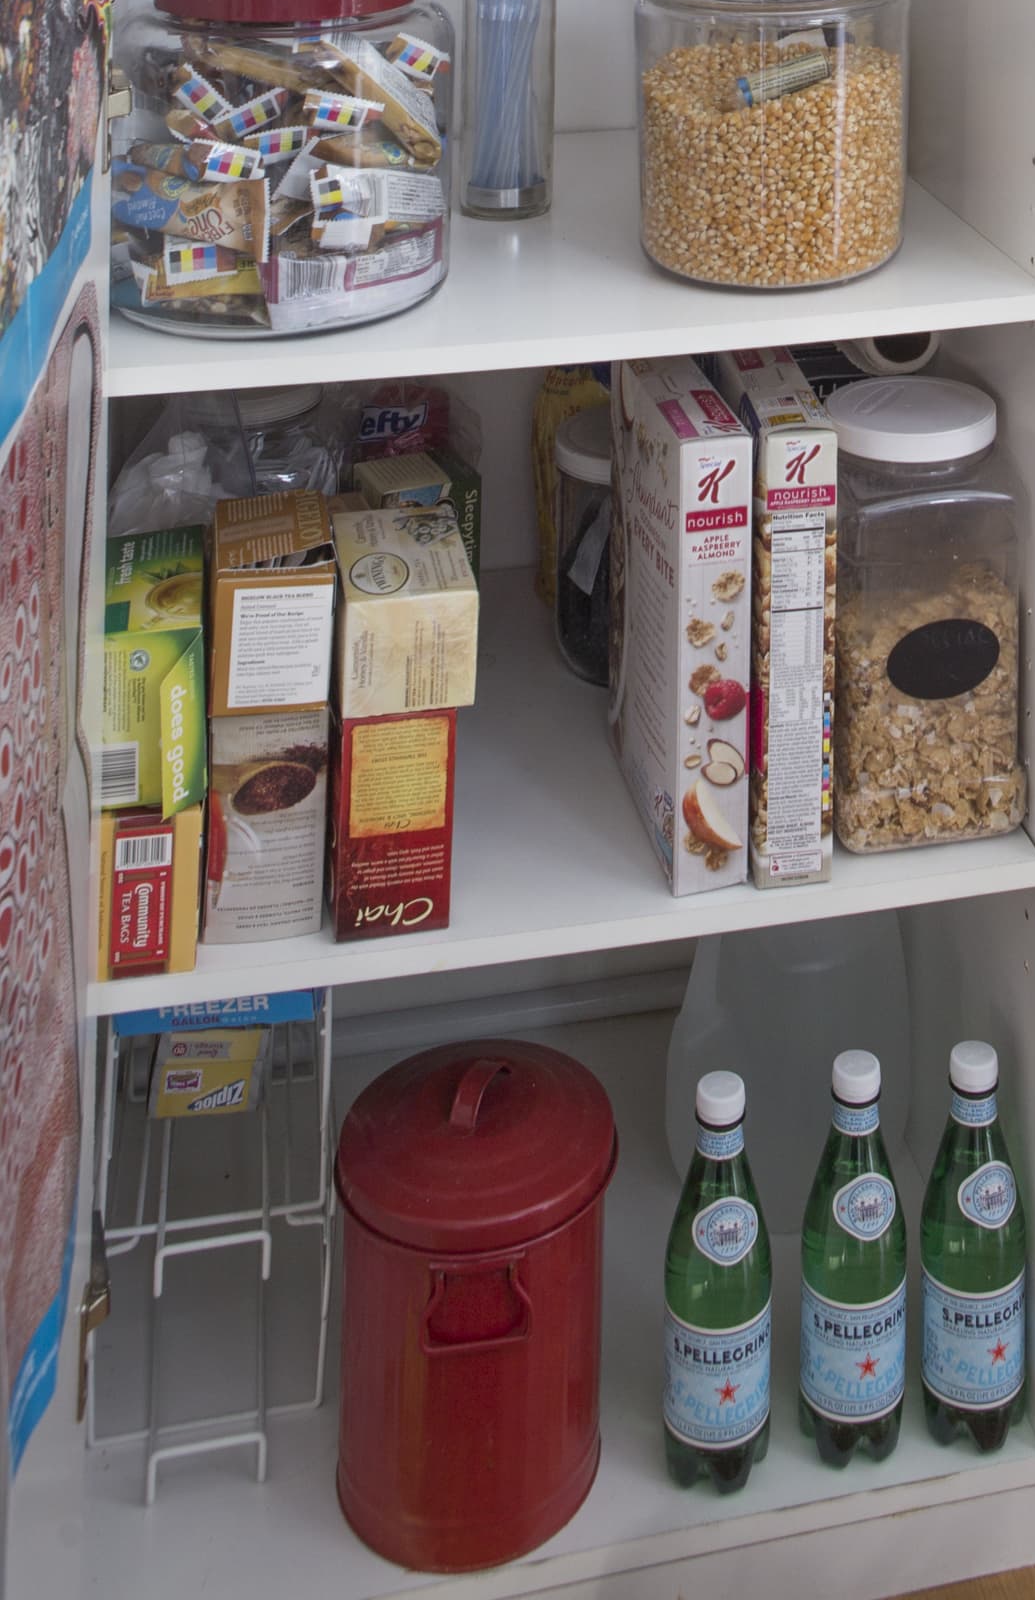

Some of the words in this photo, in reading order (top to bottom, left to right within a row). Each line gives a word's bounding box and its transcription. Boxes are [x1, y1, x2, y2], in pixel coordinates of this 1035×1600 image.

[187, 208, 222, 236] One
[785, 444, 821, 485] K
[698, 459, 736, 503] K
[774, 488, 828, 501] nourish
[687, 511, 743, 529] nourish
[772, 513, 803, 521] Nutrition
[634, 516, 655, 560] EVERY
[655, 551, 675, 589] BITE
[692, 540, 741, 553] RASPBERRY
[703, 534, 729, 544] APPLE
[697, 550, 735, 561] ALMOND
[169, 686, 188, 739] does
[167, 745, 189, 803] good
[121, 891, 132, 911] TEA
[354, 896, 434, 927] Chai
[133, 882, 153, 948] Community
[120, 916, 131, 943] BAGS
[158, 995, 269, 1020] FREEZER
[172, 1015, 219, 1027] GALLON
[674, 1322, 770, 1366] S.PELLEGRINO
